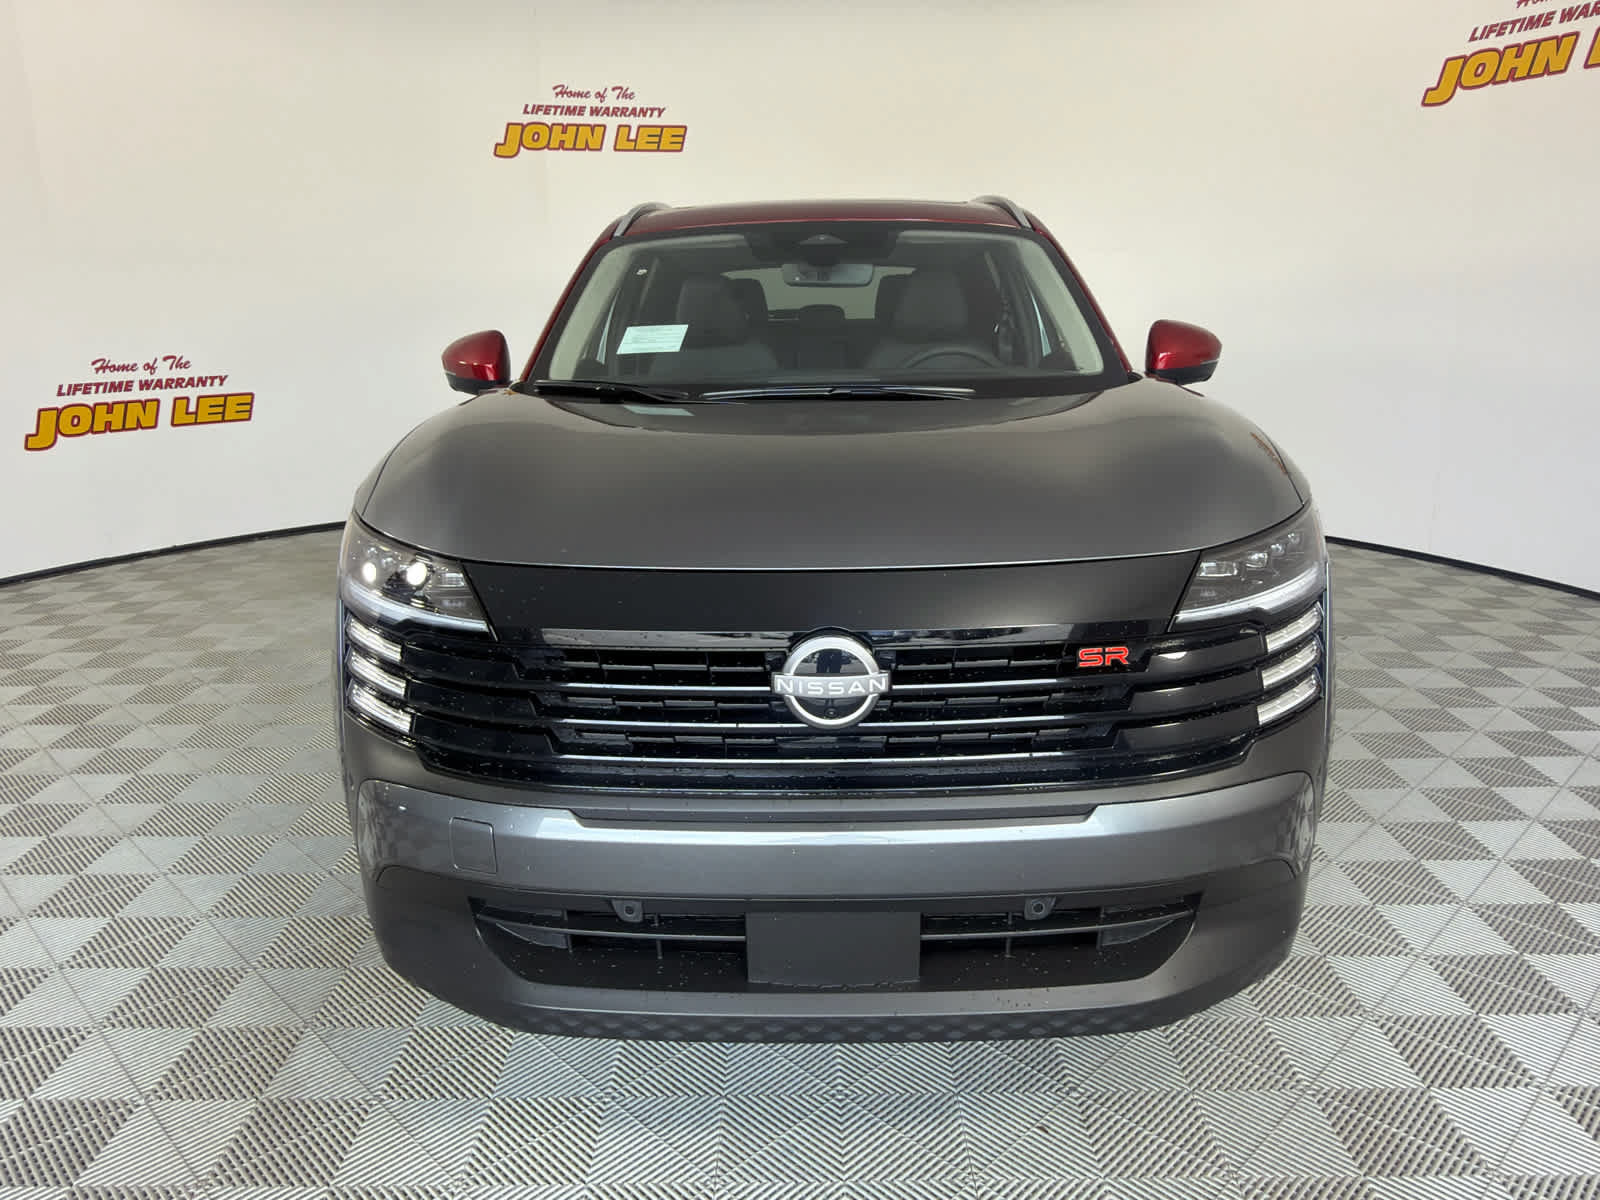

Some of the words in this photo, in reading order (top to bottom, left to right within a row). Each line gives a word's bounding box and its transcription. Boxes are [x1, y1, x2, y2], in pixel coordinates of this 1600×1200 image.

[1468, 10, 1557, 42] LIFETIME
[1421, 31, 1580, 107] JOHN
[552, 84, 591, 99] Home
[595, 88, 608, 103] of
[611, 86, 636, 100] The
[522, 104, 586, 117] LIFETIME
[590, 105, 666, 118] WARRANTY
[493, 121, 607, 159] JOHN
[613, 124, 688, 153] LEE
[90, 358, 138, 374] Home
[143, 357, 158, 375] of
[162, 355, 191, 371] The
[56, 380, 134, 397] LIFETIME
[138, 375, 228, 391] WARRANTY
[24, 398, 161, 451] JOHN
[170, 392, 255, 427] LEE
[1079, 646, 1129, 667] SR
[777, 677, 886, 695] NISSAN
